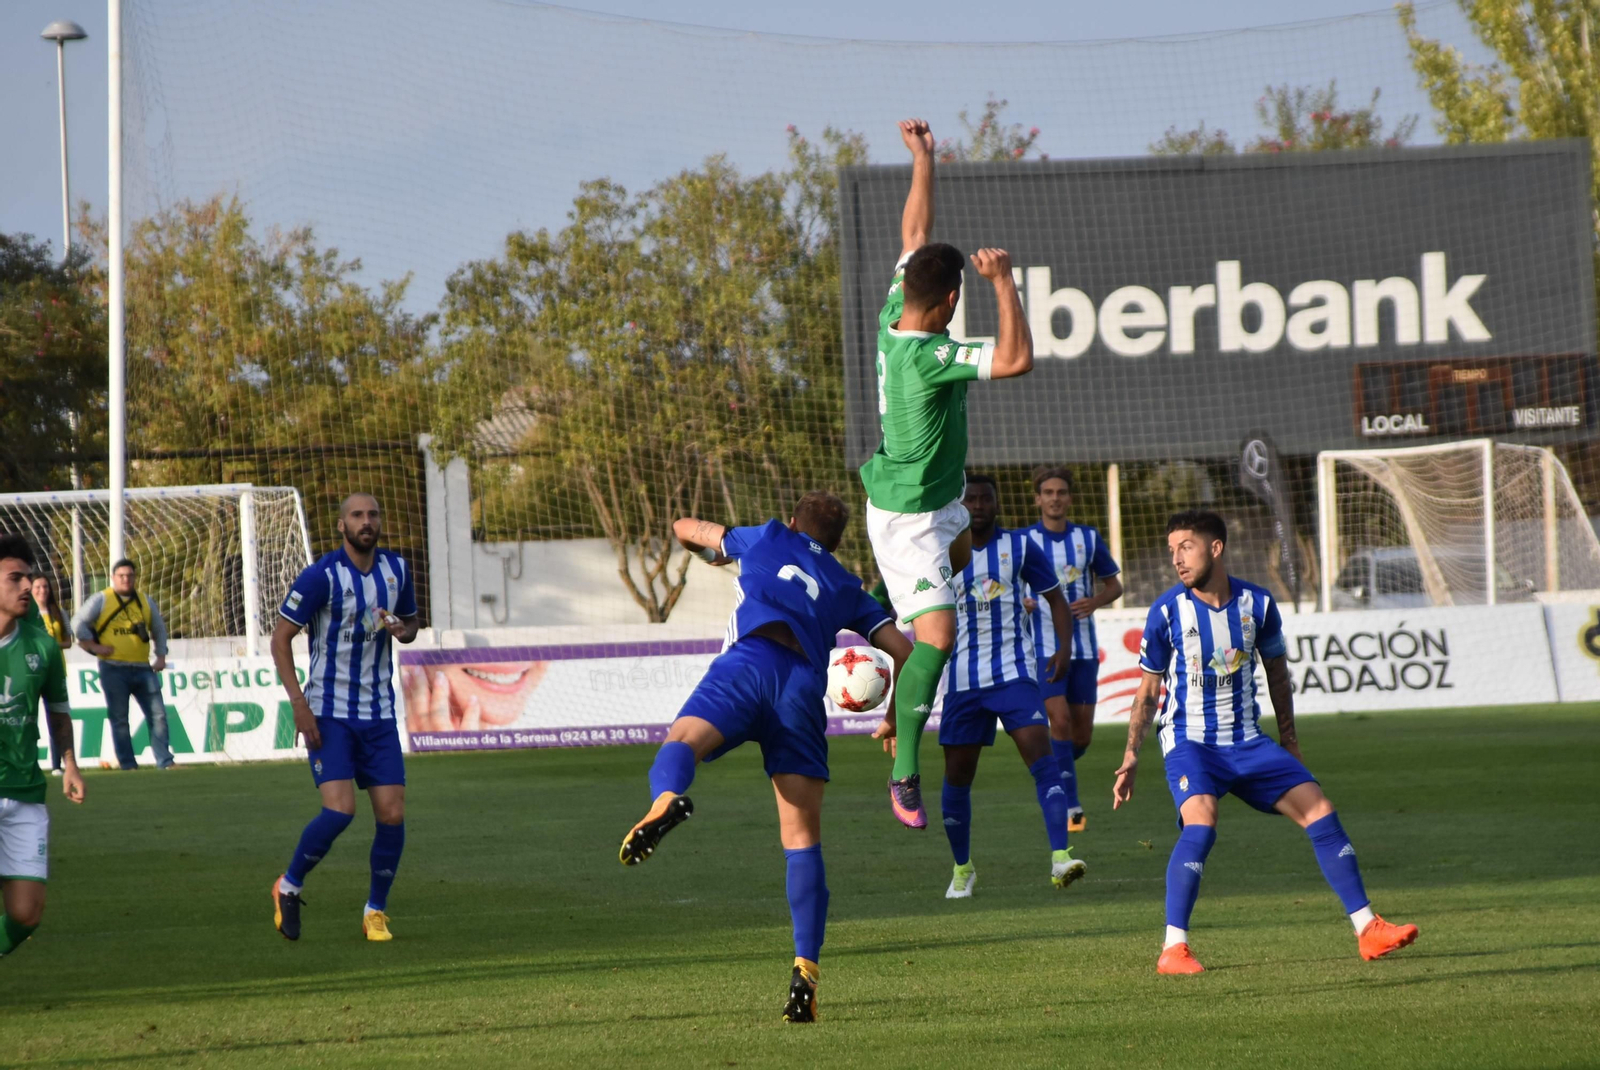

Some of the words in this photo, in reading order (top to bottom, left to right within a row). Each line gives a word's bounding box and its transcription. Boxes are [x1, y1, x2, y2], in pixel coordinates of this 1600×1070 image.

[946, 252, 1491, 360] Lberbank
[1452, 368, 1487, 382] TIEMPO
[1361, 413, 1430, 436] LOCAL
[1512, 406, 1581, 427] VISITANTE
[113, 627, 134, 636] PRE
[1284, 621, 1450, 664] UTACIÓN
[589, 657, 706, 692] médic
[40, 699, 305, 759] TAP
[842, 718, 884, 730] Mont
[412, 735, 478, 747] Villanueva
[481, 733, 497, 744] de
[500, 733, 512, 744] la
[514, 732, 558, 744] Serena
[560, 730, 588, 743] (924
[590, 730, 607, 741] 84
[609, 729, 626, 740] 30
[627, 728, 649, 741] 91)
